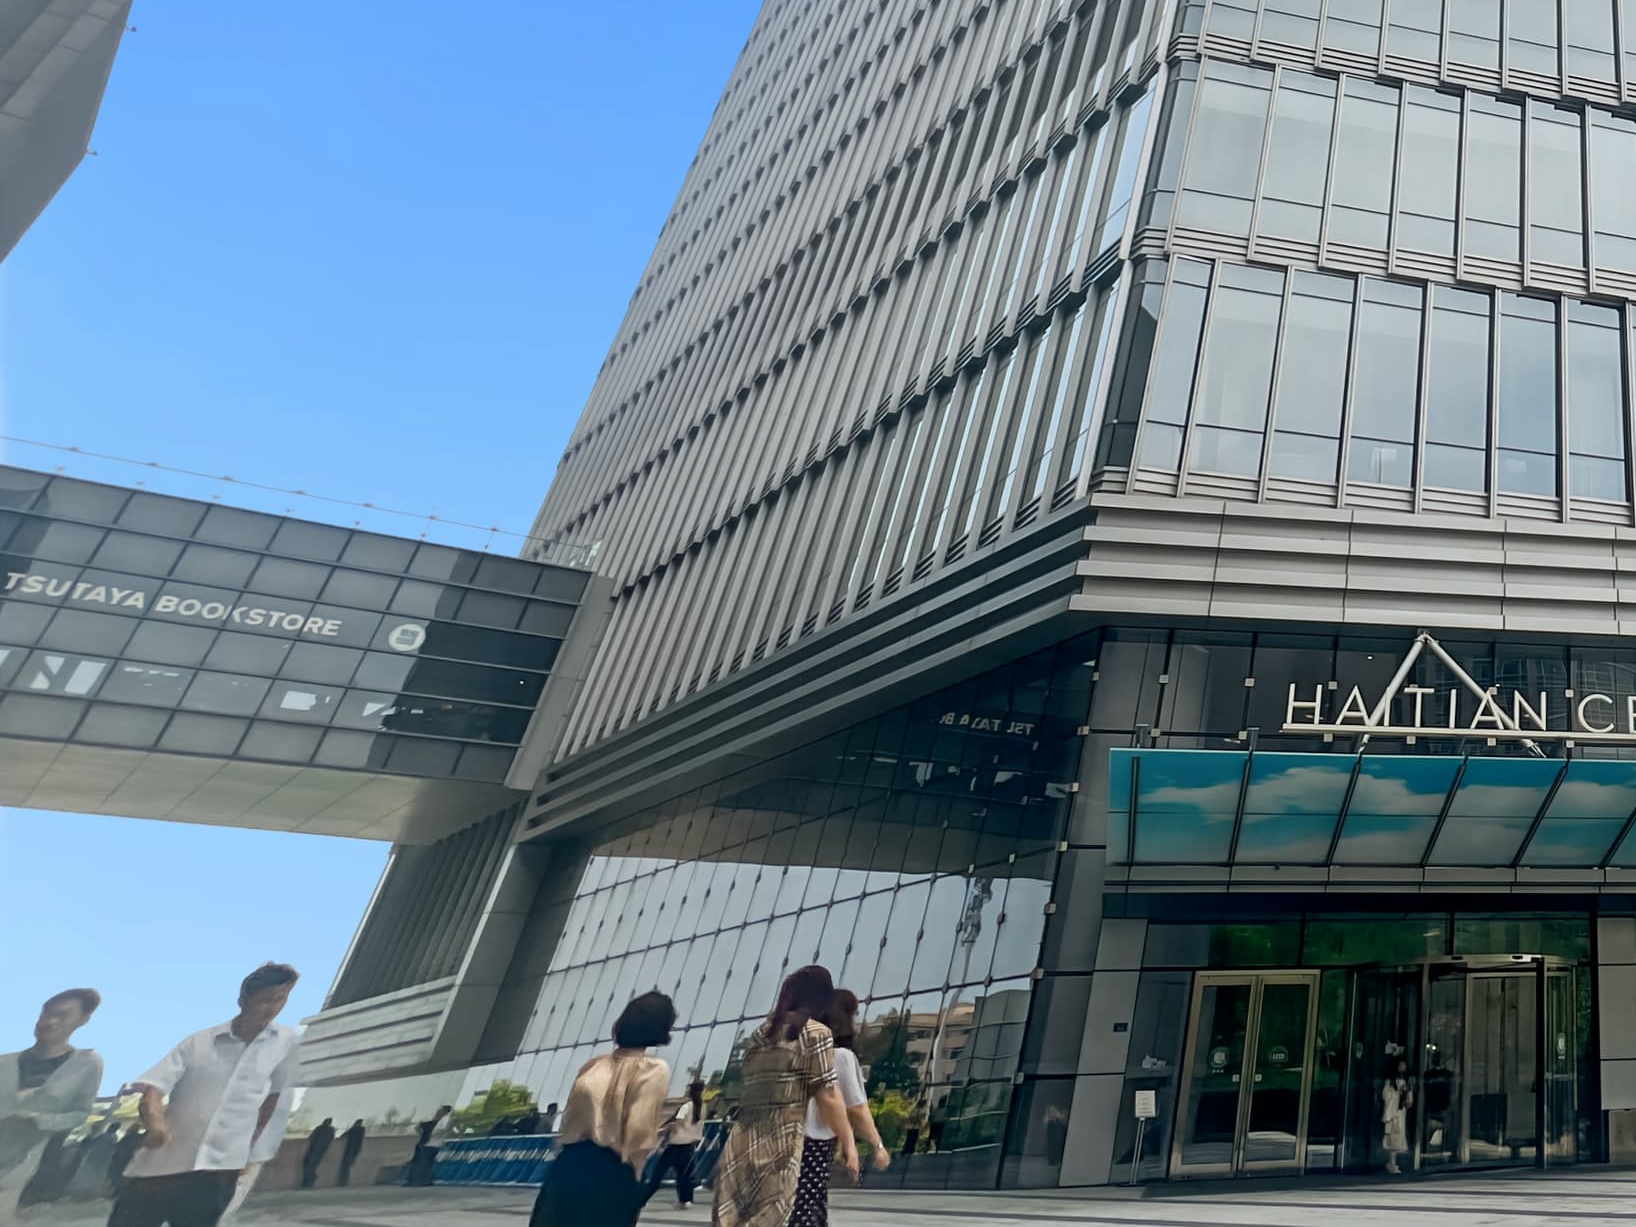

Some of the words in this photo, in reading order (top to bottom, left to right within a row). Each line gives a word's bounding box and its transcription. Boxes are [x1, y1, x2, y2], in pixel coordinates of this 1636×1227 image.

[4, 572, 145, 610] TSUTAYA
[155, 595, 342, 636] BOOKSTORE
[1286, 683, 1547, 730] HAITIAN
